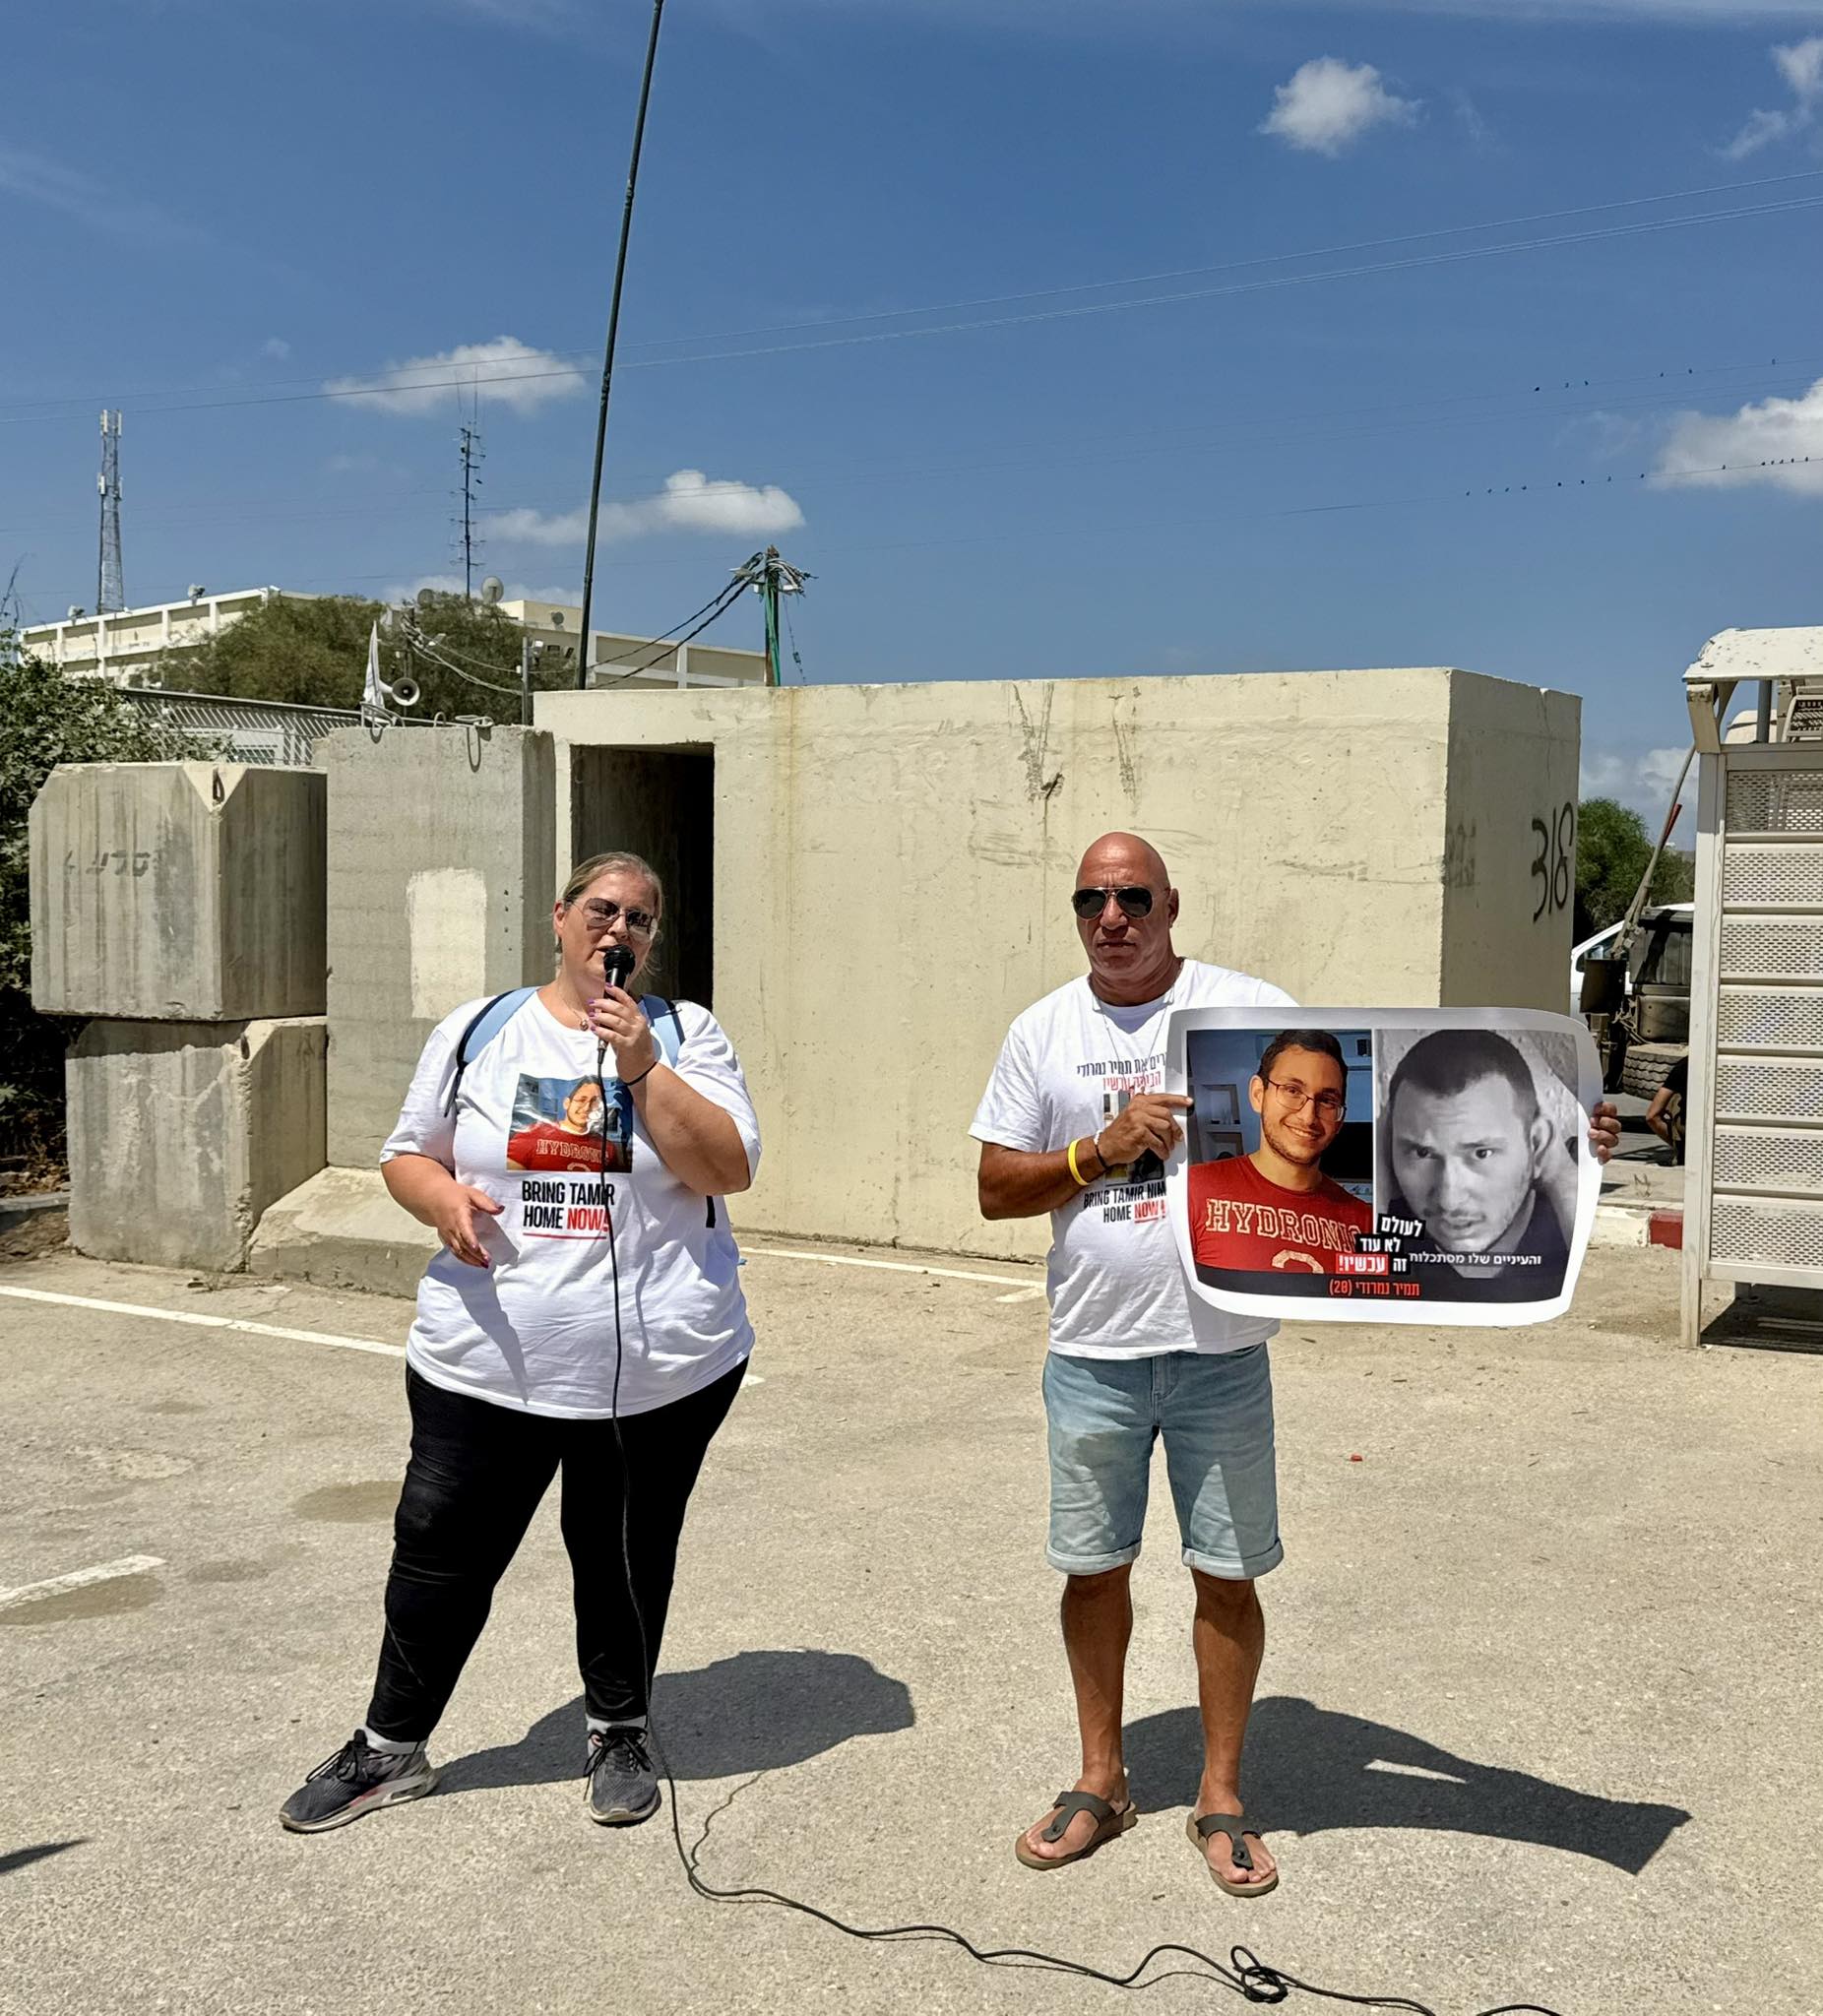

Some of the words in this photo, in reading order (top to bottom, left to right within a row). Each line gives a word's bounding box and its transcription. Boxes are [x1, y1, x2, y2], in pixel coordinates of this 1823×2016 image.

[1107, 1060, 1132, 1074] תמיר
[1150, 1052, 1166, 1070] רים
[1077, 1062, 1105, 1078] נמרודי
[522, 1180, 566, 1204] BRING
[1084, 1189, 1110, 1210] BRING
[1113, 1185, 1144, 1204] TAMIR
[523, 1205, 564, 1229] HOME
[1103, 1205, 1132, 1224] HOME
[1381, 1216, 1423, 1237] לעולם
[1359, 1237, 1381, 1253] עוד
[1384, 1236, 1402, 1253] לא
[1339, 1254, 1385, 1273] עכשיו!
[1393, 1258, 1408, 1272] זה
[1468, 1252, 1490, 1265] שלו
[1493, 1254, 1541, 1266] והעיניים
[1355, 1281, 1390, 1295] נמרודי
[1393, 1282, 1419, 1296] תמיר
